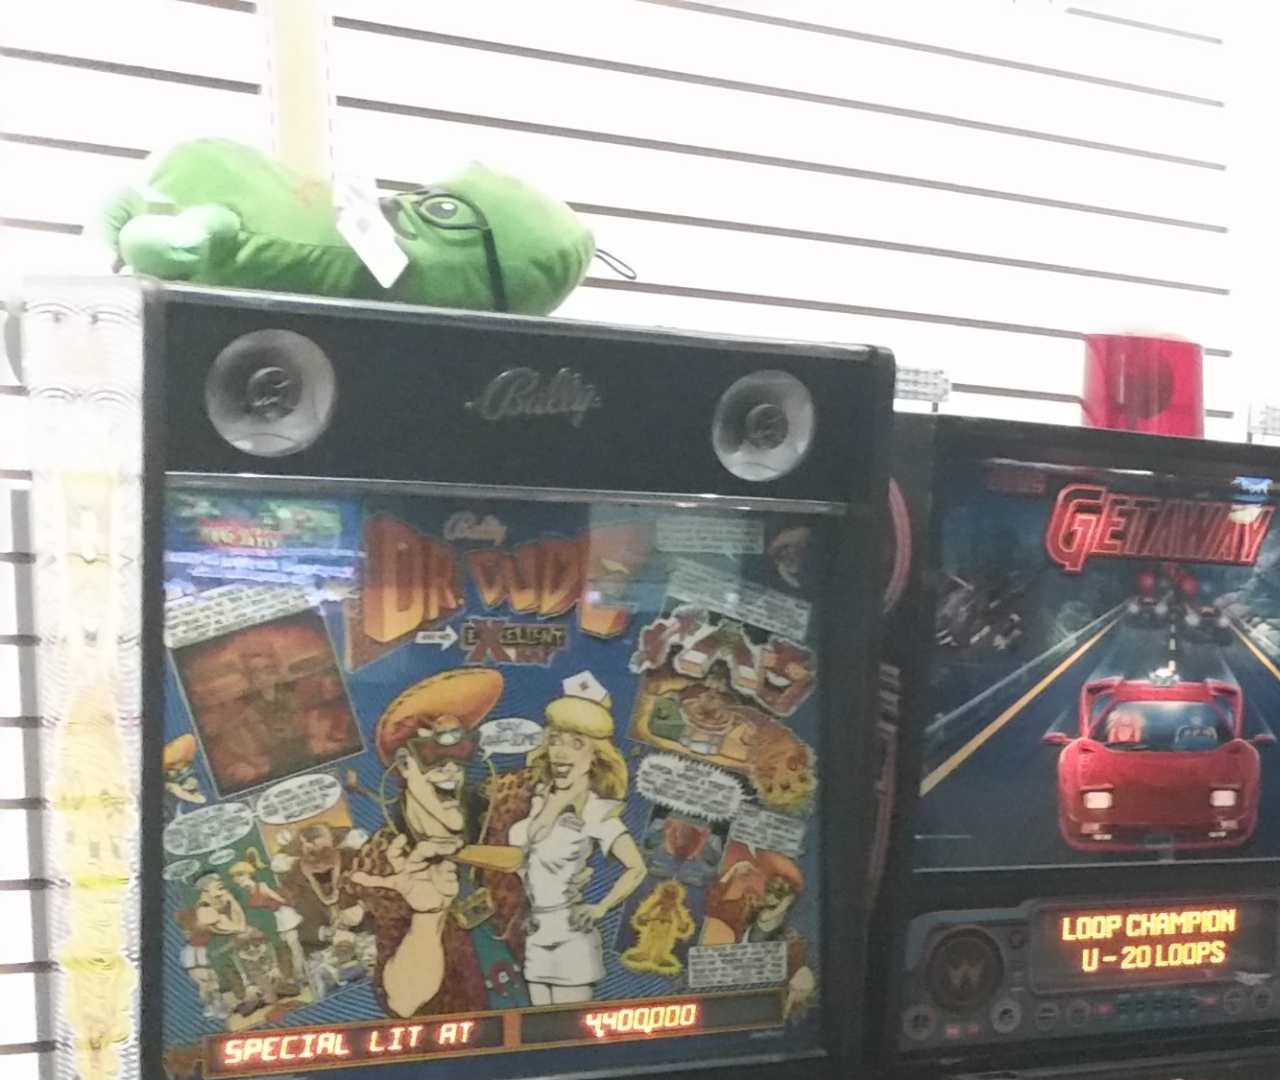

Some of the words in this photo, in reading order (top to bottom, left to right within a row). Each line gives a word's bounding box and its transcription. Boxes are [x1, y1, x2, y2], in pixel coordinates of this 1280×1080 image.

[464, 367, 600, 428] Bally
[1045, 483, 1276, 573] GETAWAY
[460, 518, 656, 638] DUDE
[1062, 914, 1122, 942] LOOP
[1126, 908, 1237, 938] CHAMPION
[1082, 948, 1099, 973] U
[1121, 944, 1152, 969] 20
[1155, 941, 1226, 968] LOOPS
[223, 1032, 350, 1065] SPECIAL
[369, 1025, 424, 1053] LIT
[438, 1021, 476, 1046] AT
